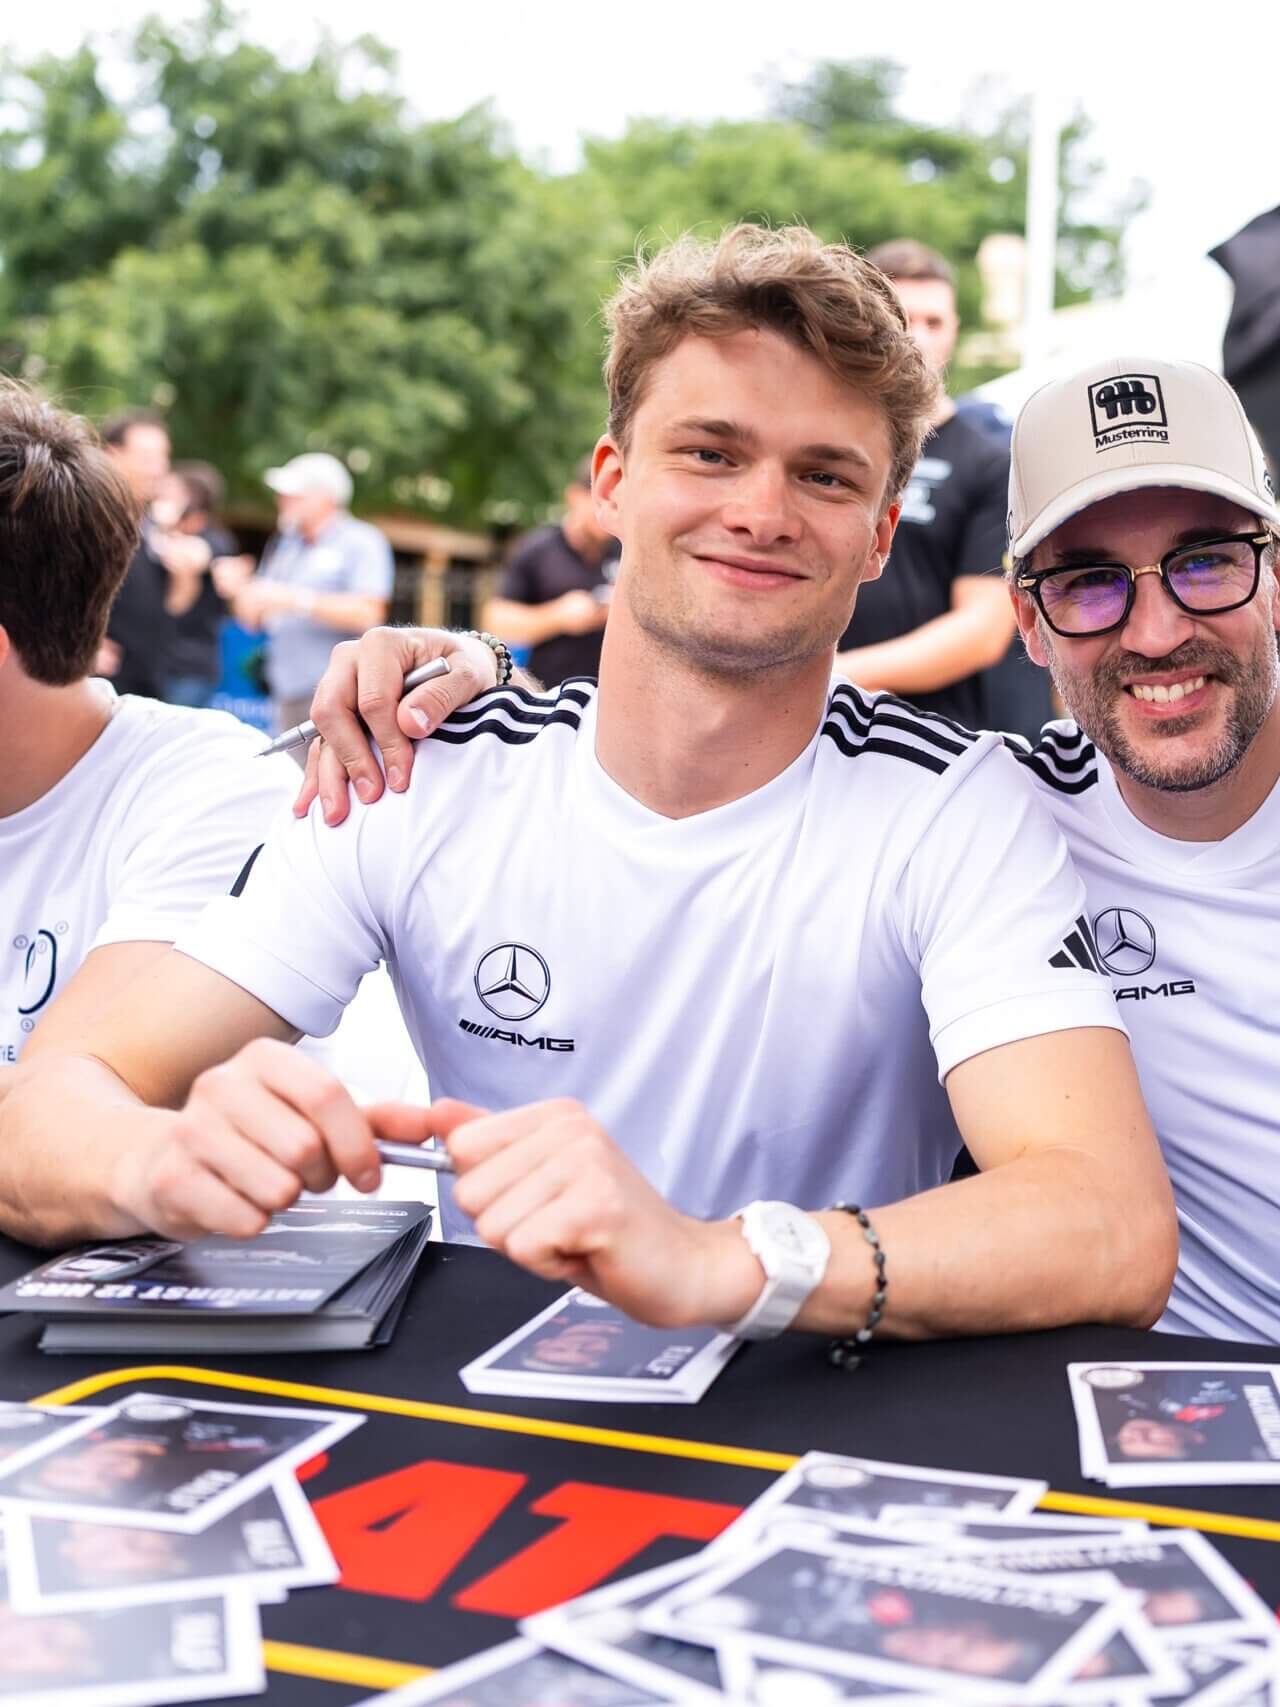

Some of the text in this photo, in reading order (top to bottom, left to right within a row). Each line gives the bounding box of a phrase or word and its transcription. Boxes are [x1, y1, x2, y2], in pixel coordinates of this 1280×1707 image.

[1095, 426, 1169, 448] Musterring
[1114, 980, 1196, 1002] AMG
[488, 1027, 575, 1052] AMG
